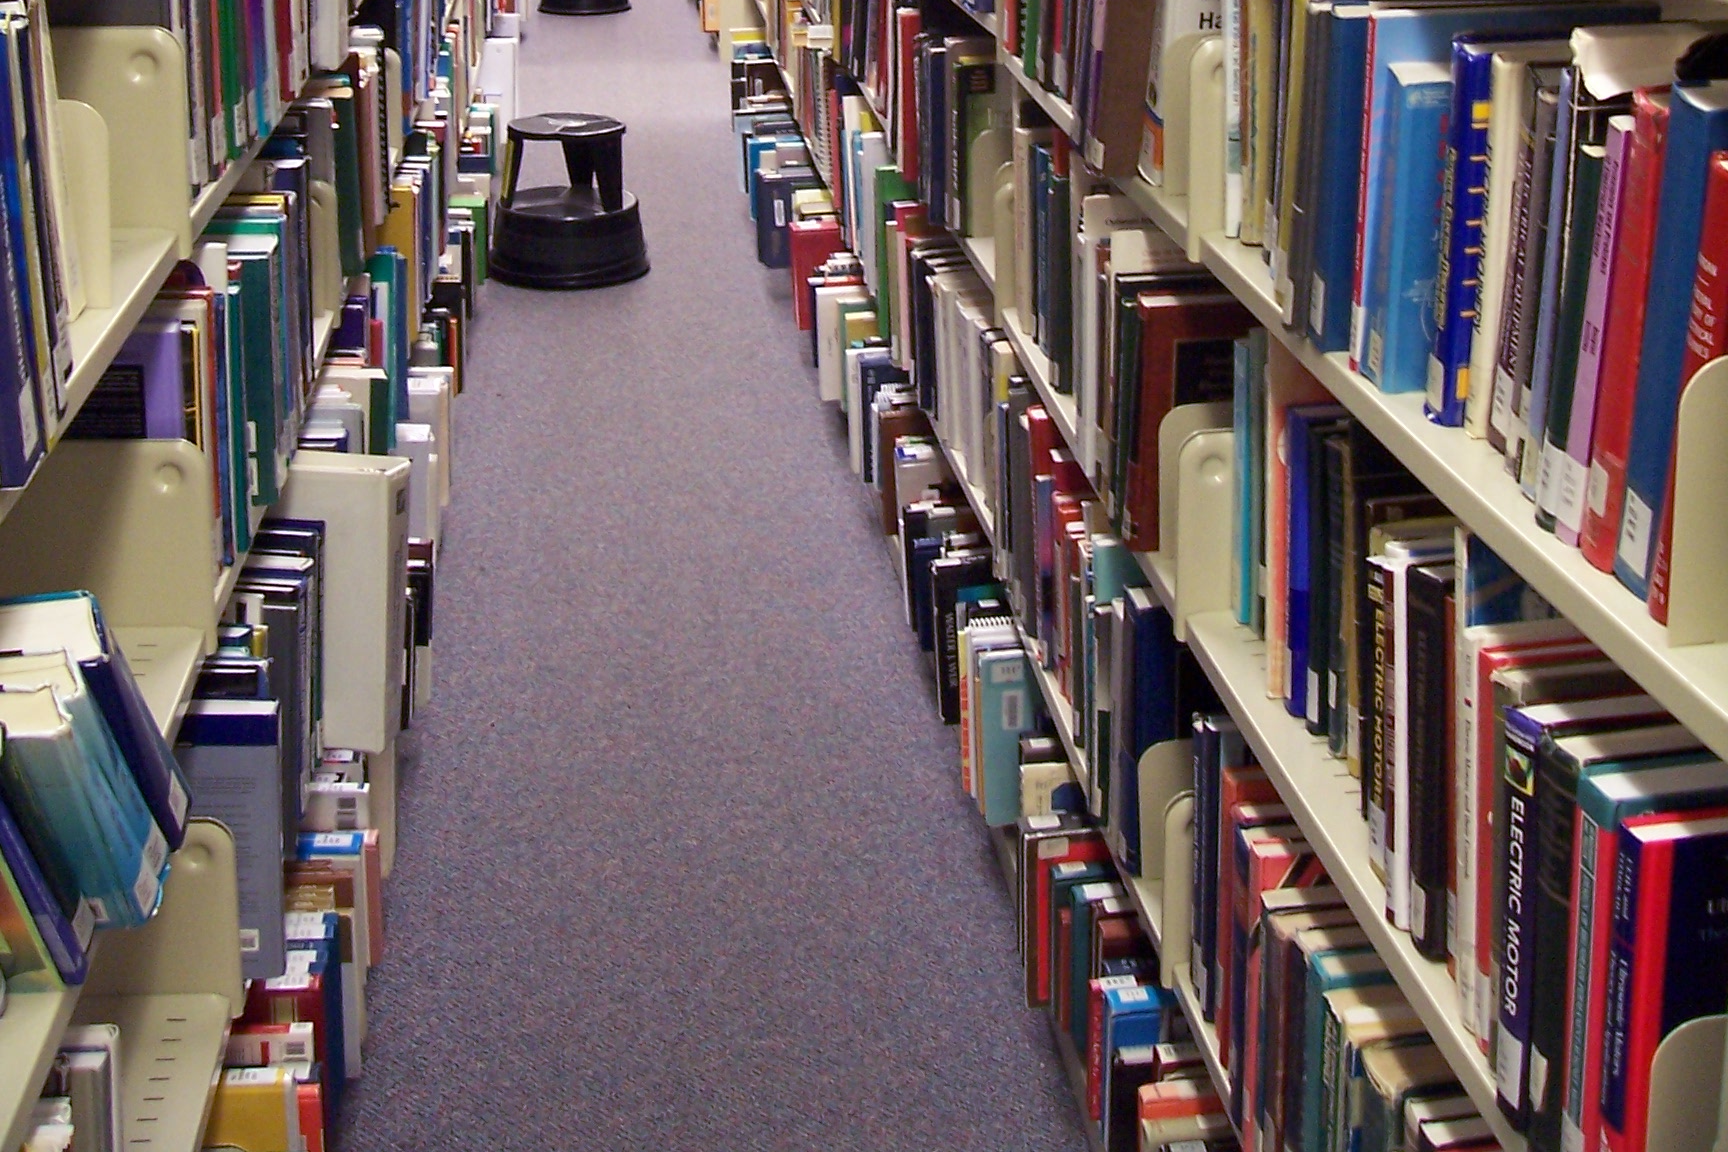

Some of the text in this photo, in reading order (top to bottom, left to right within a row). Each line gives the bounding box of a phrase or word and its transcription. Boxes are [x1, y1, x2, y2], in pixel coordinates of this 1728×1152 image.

[1373, 609, 1385, 713] ELECTRIC
[1504, 796, 1525, 1017] ELECTRIC MOTOR
